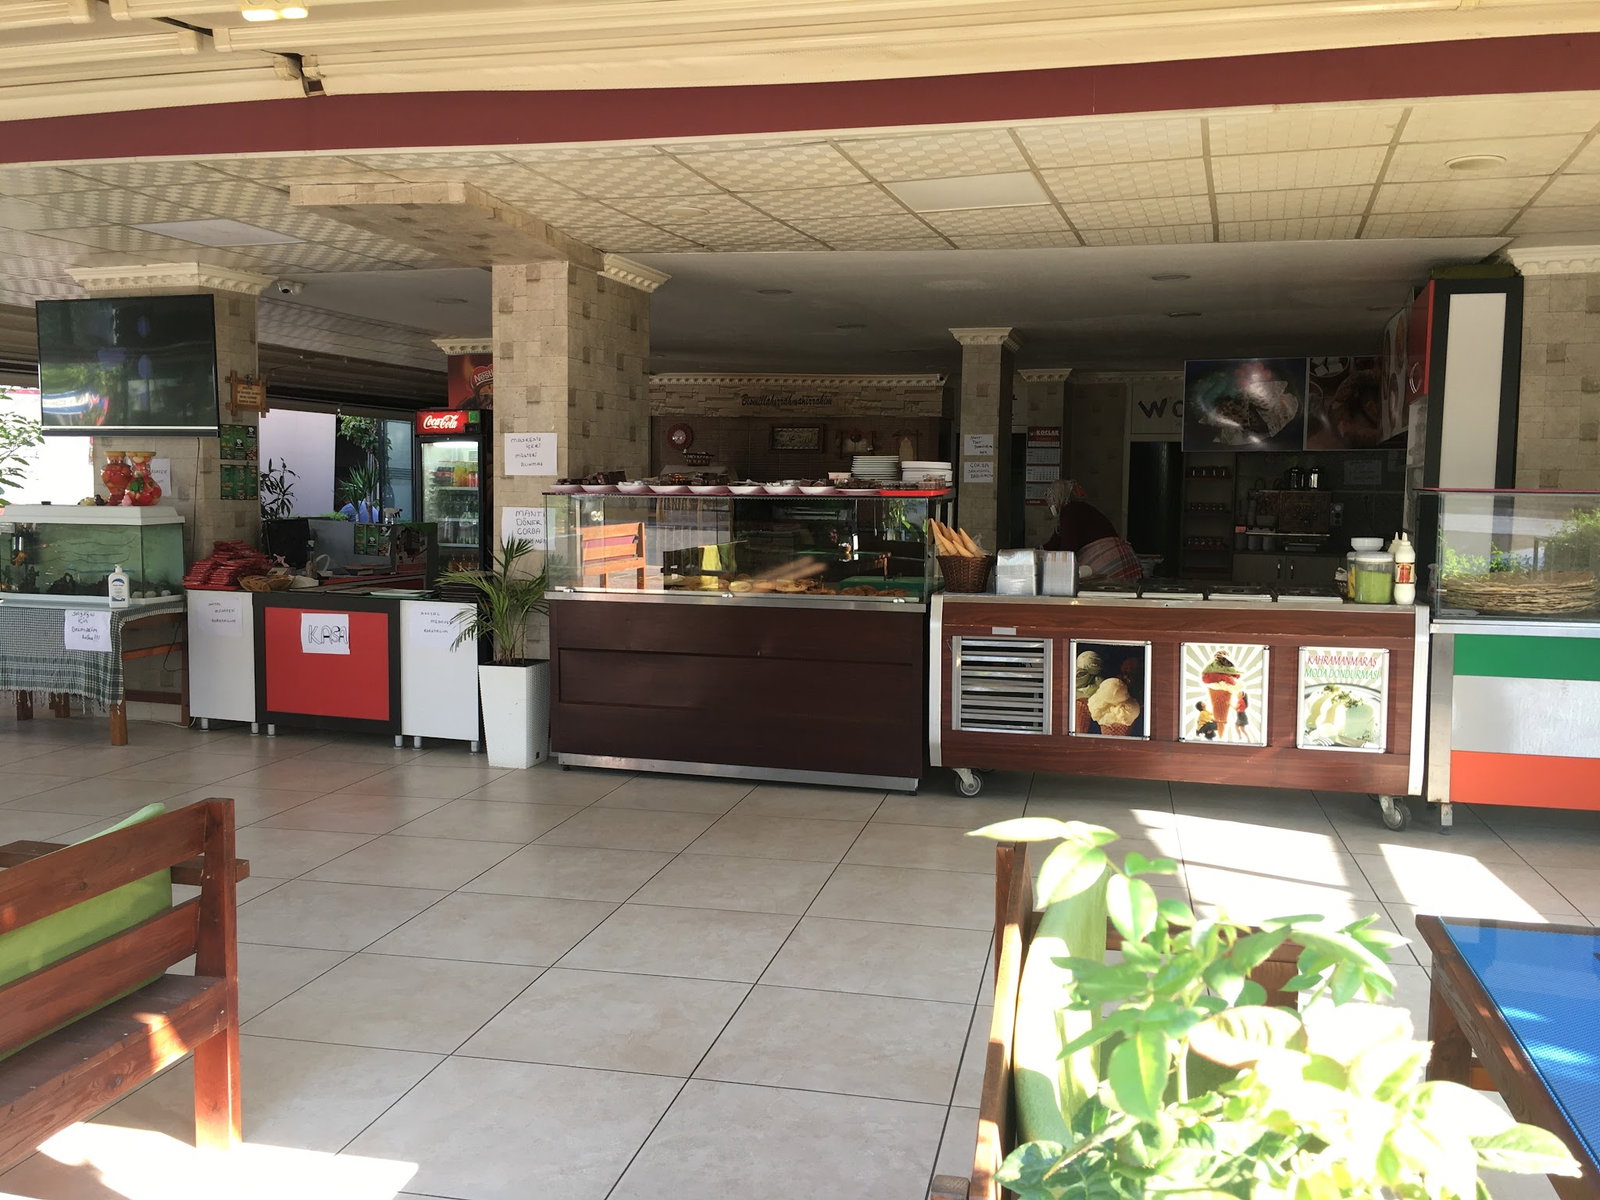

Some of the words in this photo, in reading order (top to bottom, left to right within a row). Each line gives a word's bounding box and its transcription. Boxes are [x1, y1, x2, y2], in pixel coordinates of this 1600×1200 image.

[423, 414, 460, 430] Coca-Cola
[308, 624, 349, 645] KASA
[1307, 655, 1377, 668] KAHRAMANMARAŞ
